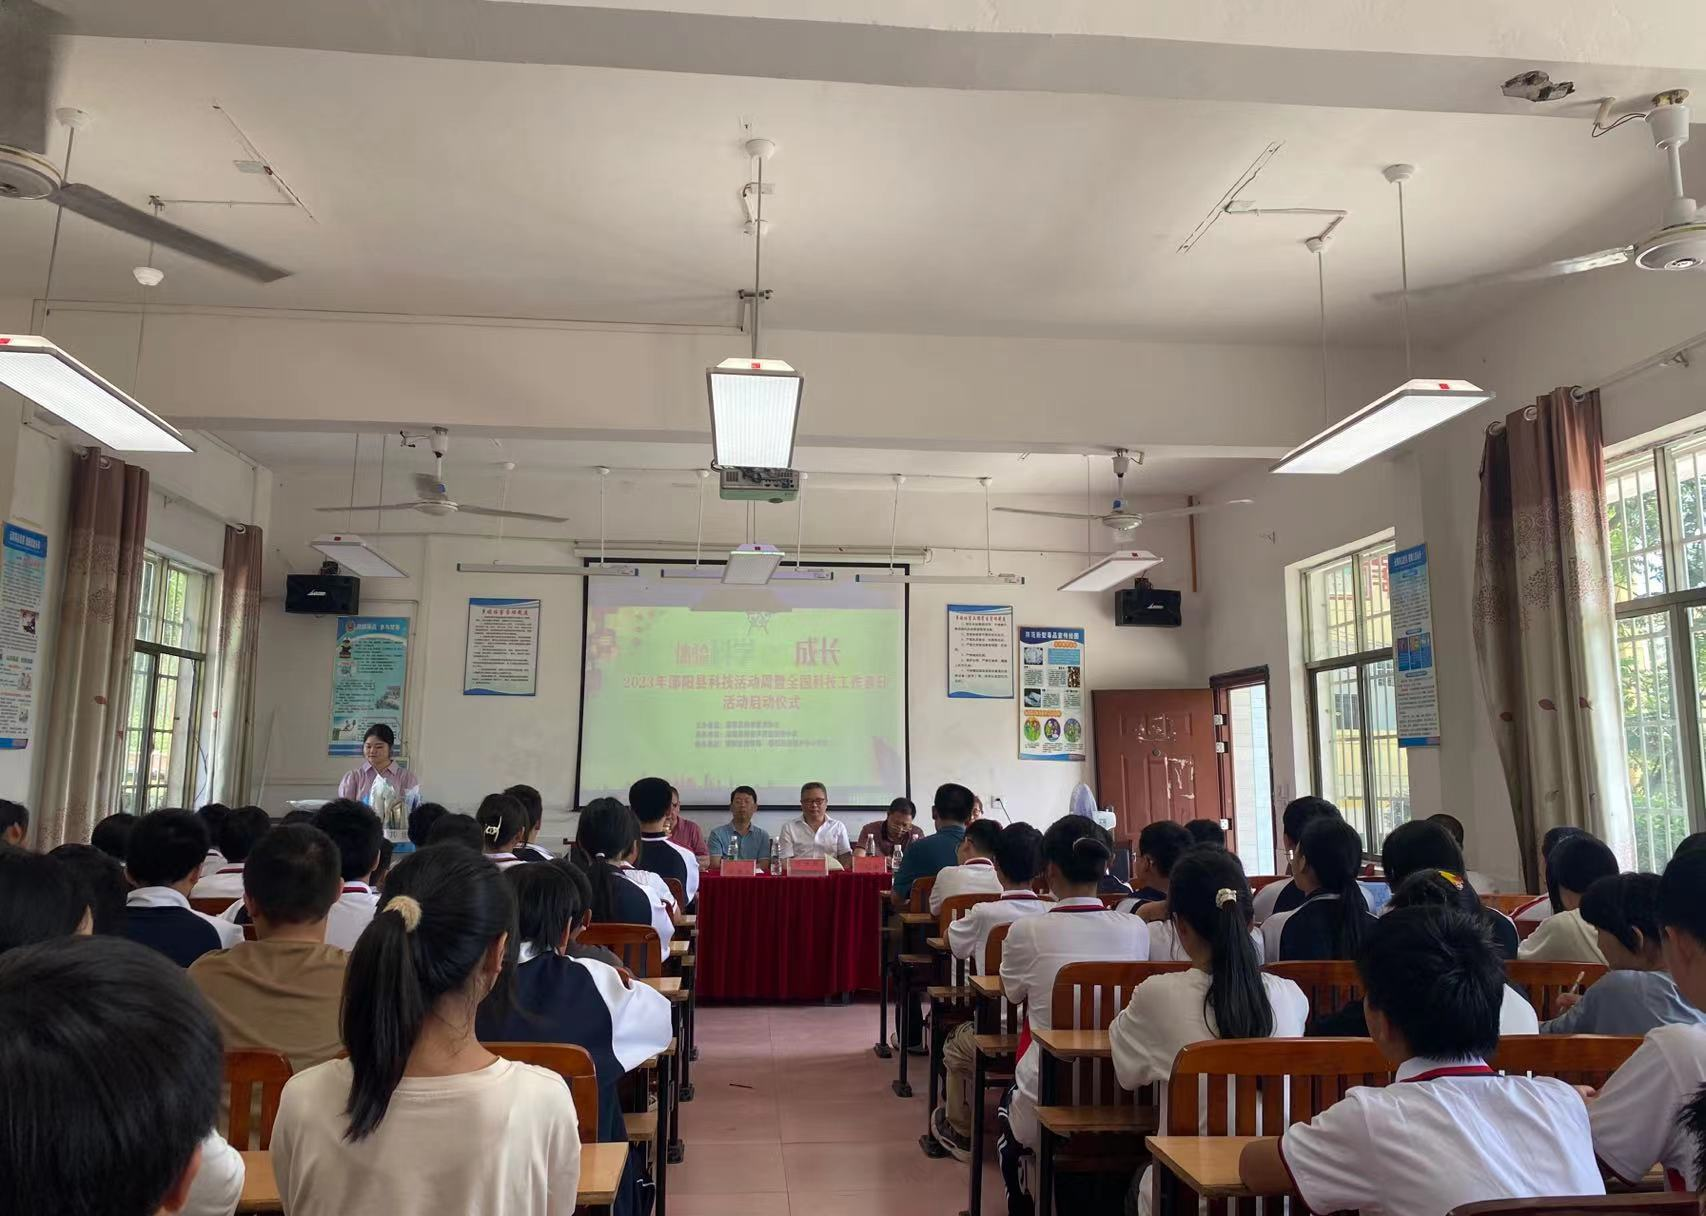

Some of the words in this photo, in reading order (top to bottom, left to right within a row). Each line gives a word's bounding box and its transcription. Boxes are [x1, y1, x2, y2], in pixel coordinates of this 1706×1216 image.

[795, 637, 840, 667] 成长
[723, 695, 801, 710] 活动启动仪式
